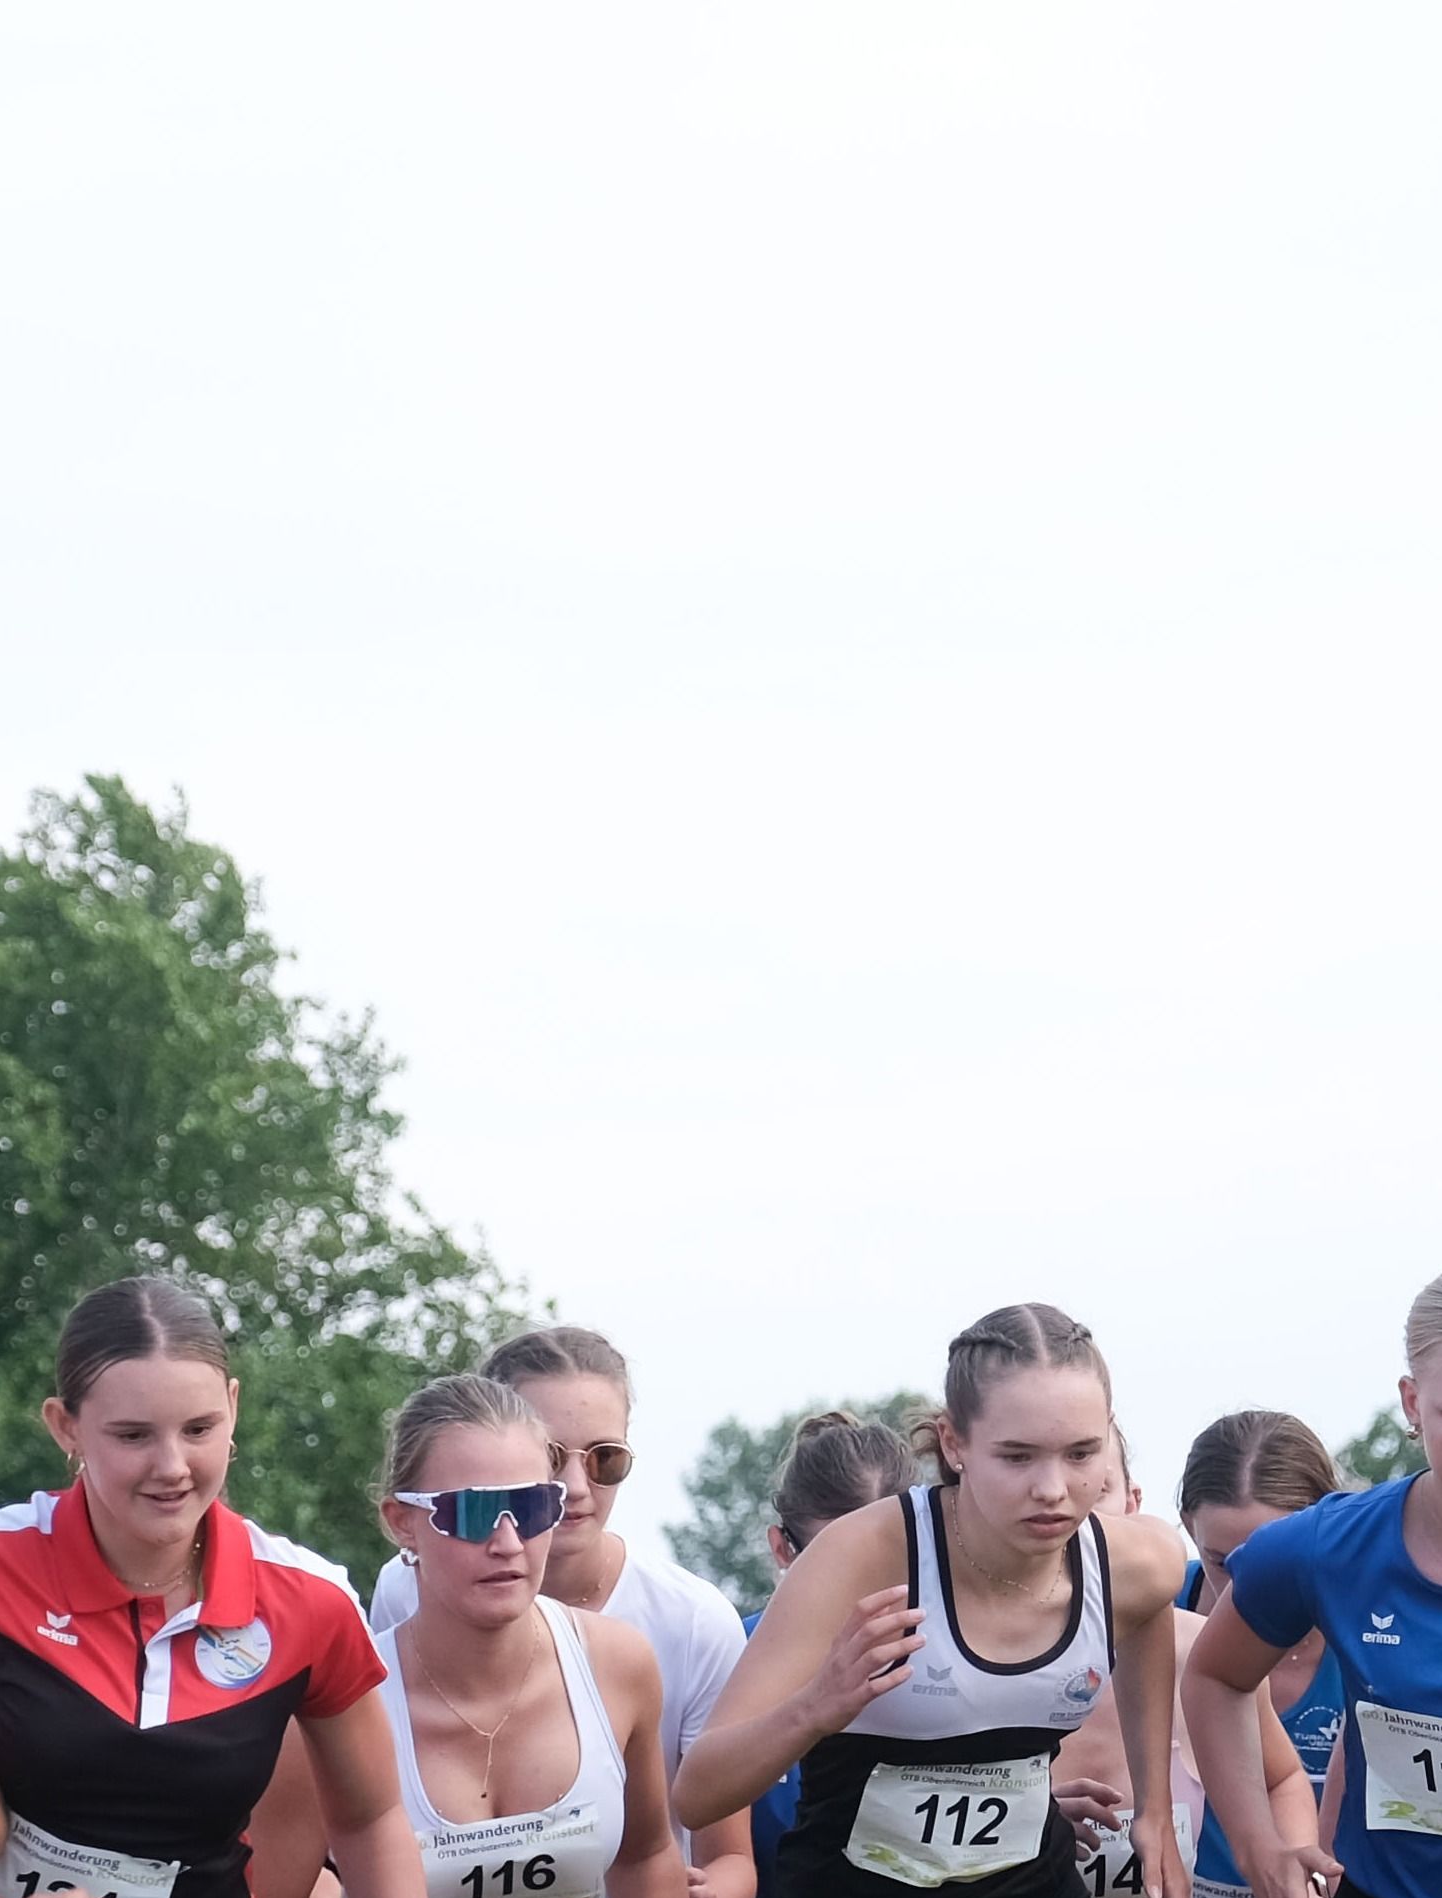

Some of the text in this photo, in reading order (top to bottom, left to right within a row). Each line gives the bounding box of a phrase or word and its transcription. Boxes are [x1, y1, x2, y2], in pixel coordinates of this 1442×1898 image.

[1362, 1631, 1400, 1645] erima
[911, 1683, 958, 1697] erima
[434, 1819, 544, 1848] Jahnwanderung
[914, 1794, 1009, 1846] 112
[13, 1820, 121, 1872] Jahnwanderung
[1084, 1853, 1143, 1897] 14
